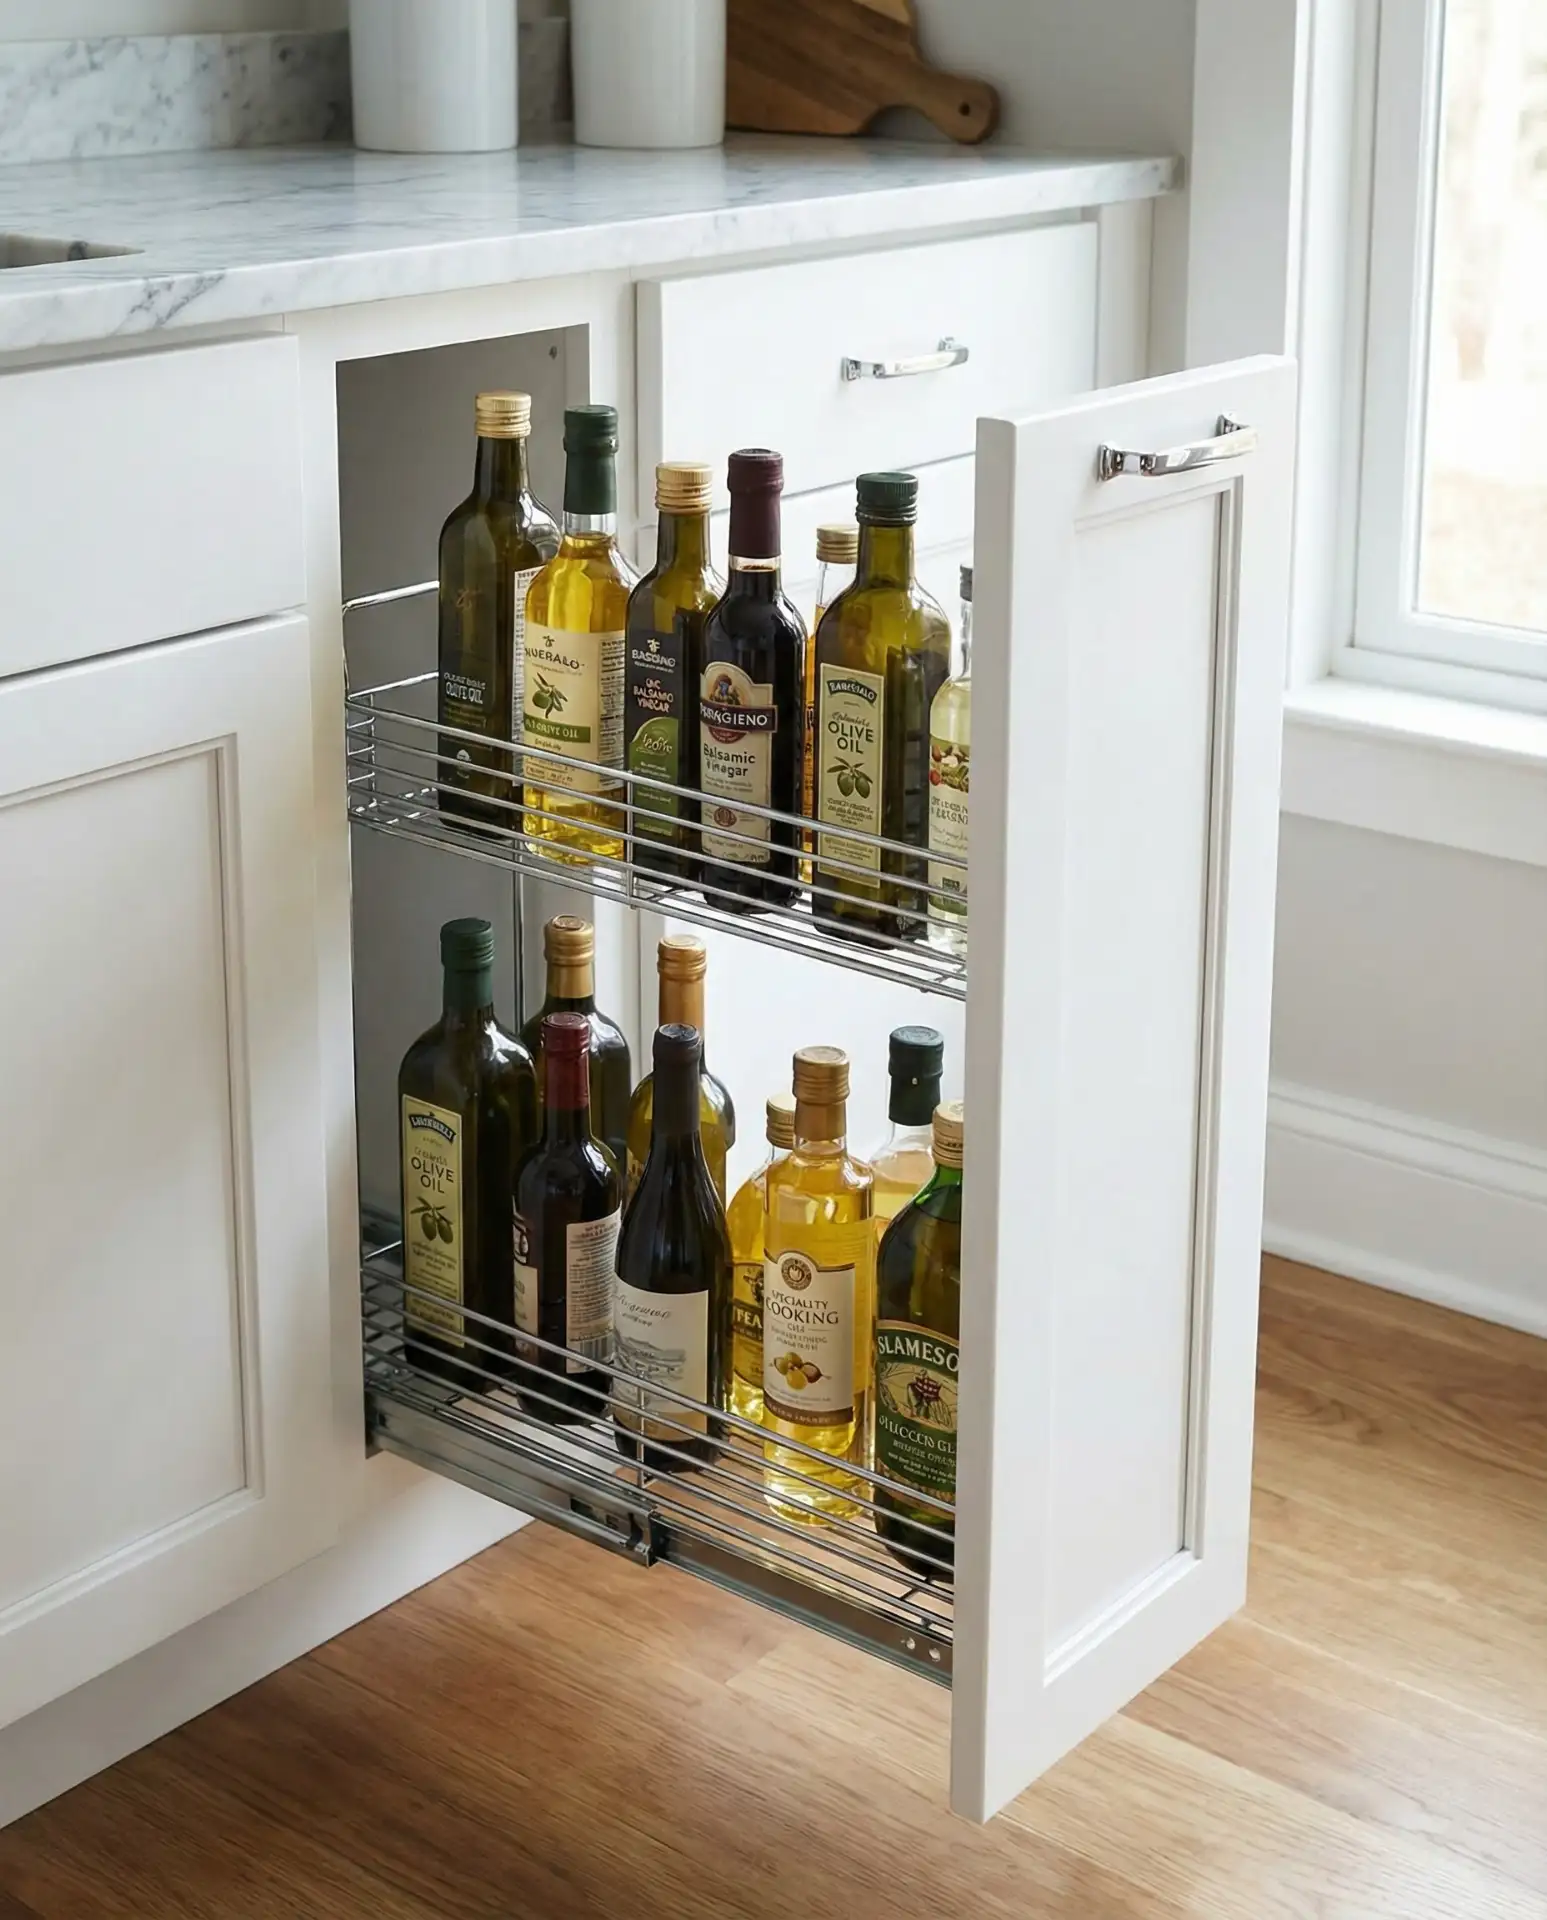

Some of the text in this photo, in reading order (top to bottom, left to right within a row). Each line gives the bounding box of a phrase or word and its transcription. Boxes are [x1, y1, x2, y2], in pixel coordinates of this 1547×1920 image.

[827, 720, 874, 743] OLIVE
[703, 742, 756, 764] Balsamic
[836, 736, 864, 755] OIL
[410, 1156, 455, 1183] OLIVE
[420, 1174, 445, 1194] OIL
[765, 1296, 839, 1325] COOKING
